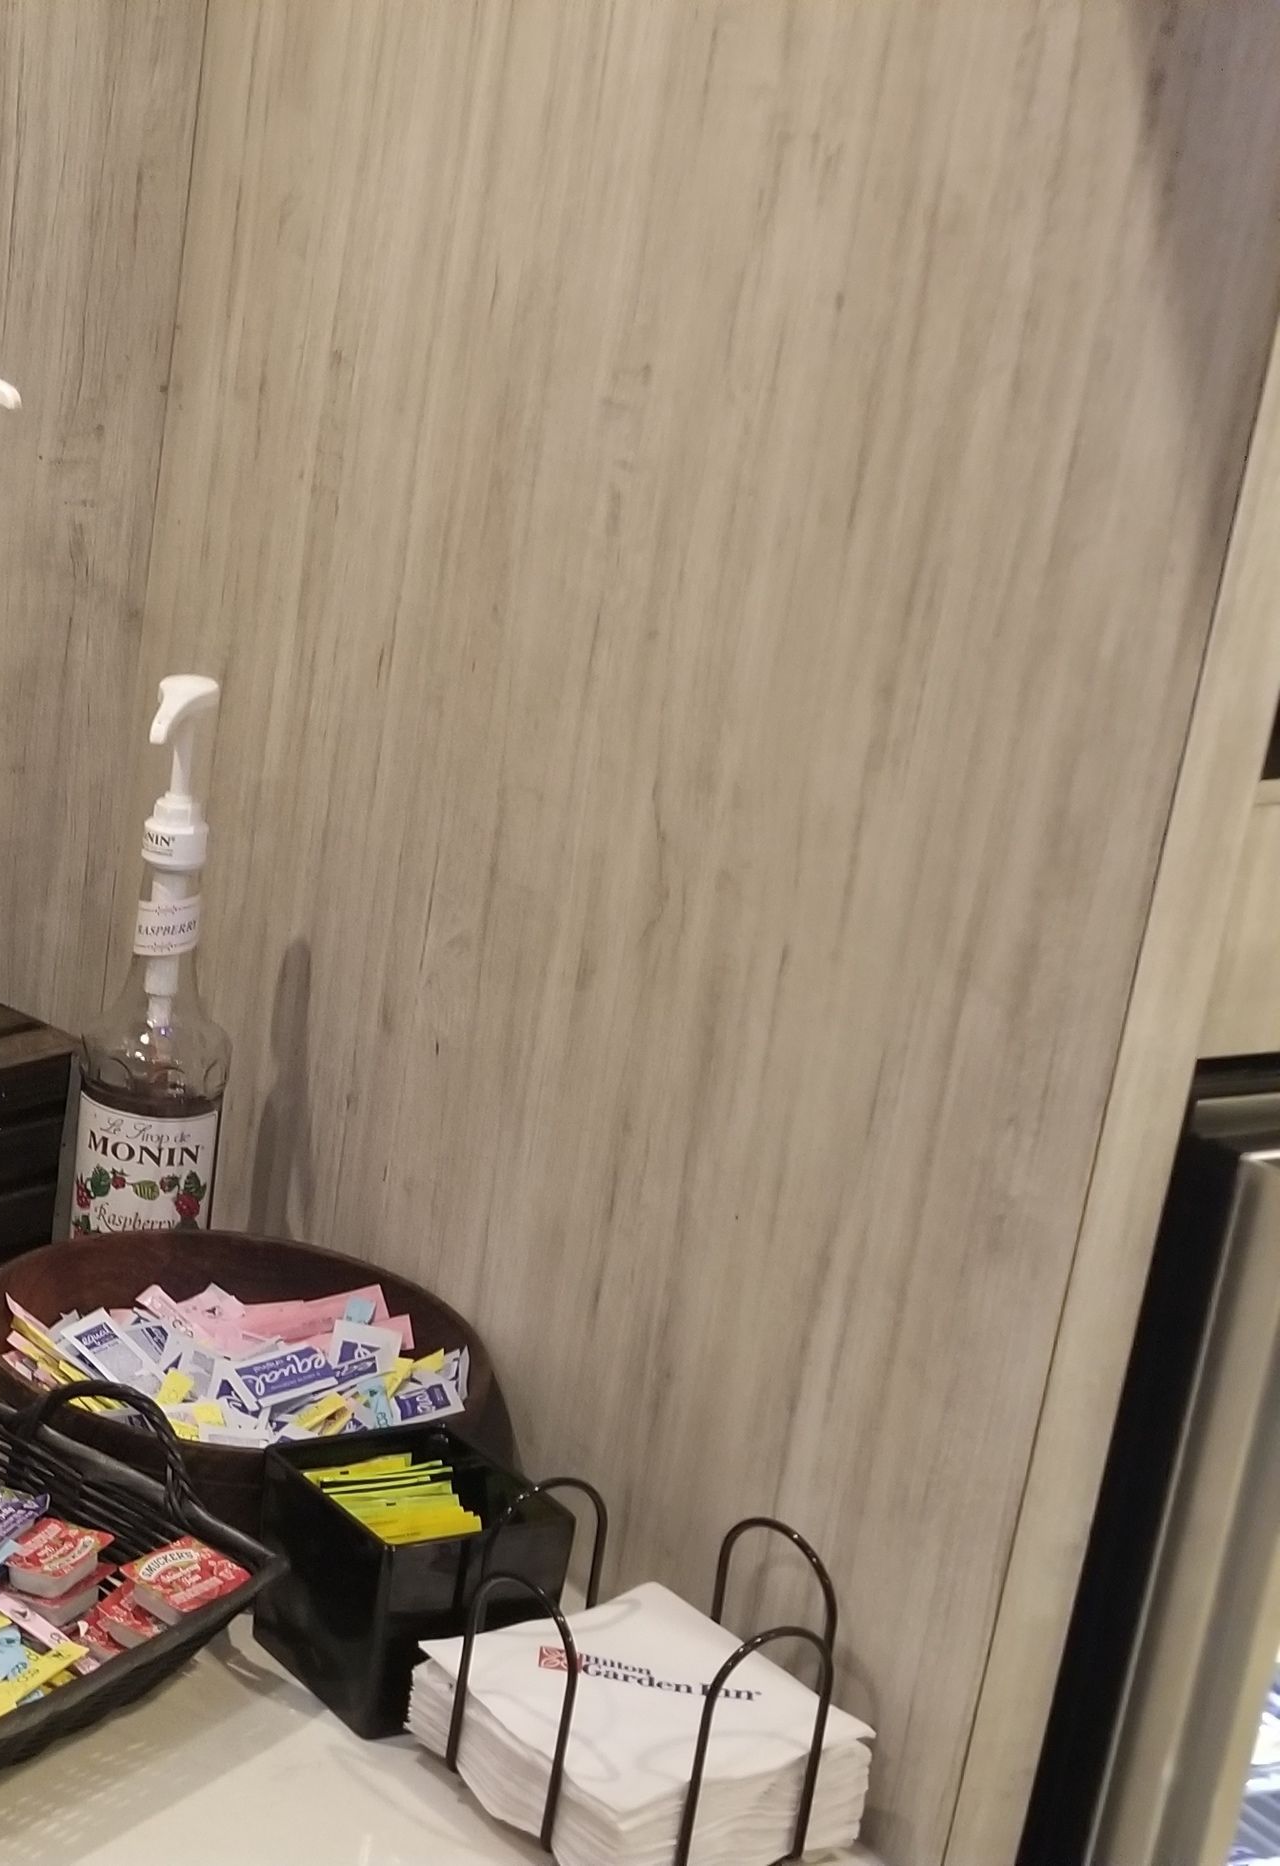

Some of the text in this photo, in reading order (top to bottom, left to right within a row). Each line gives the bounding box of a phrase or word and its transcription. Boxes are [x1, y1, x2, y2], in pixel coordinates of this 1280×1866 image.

[87, 1128, 200, 1168] MONIN
[81, 1322, 113, 1347] equal
[242, 1347, 326, 1396] equal
[582, 1663, 693, 1695] Garden
